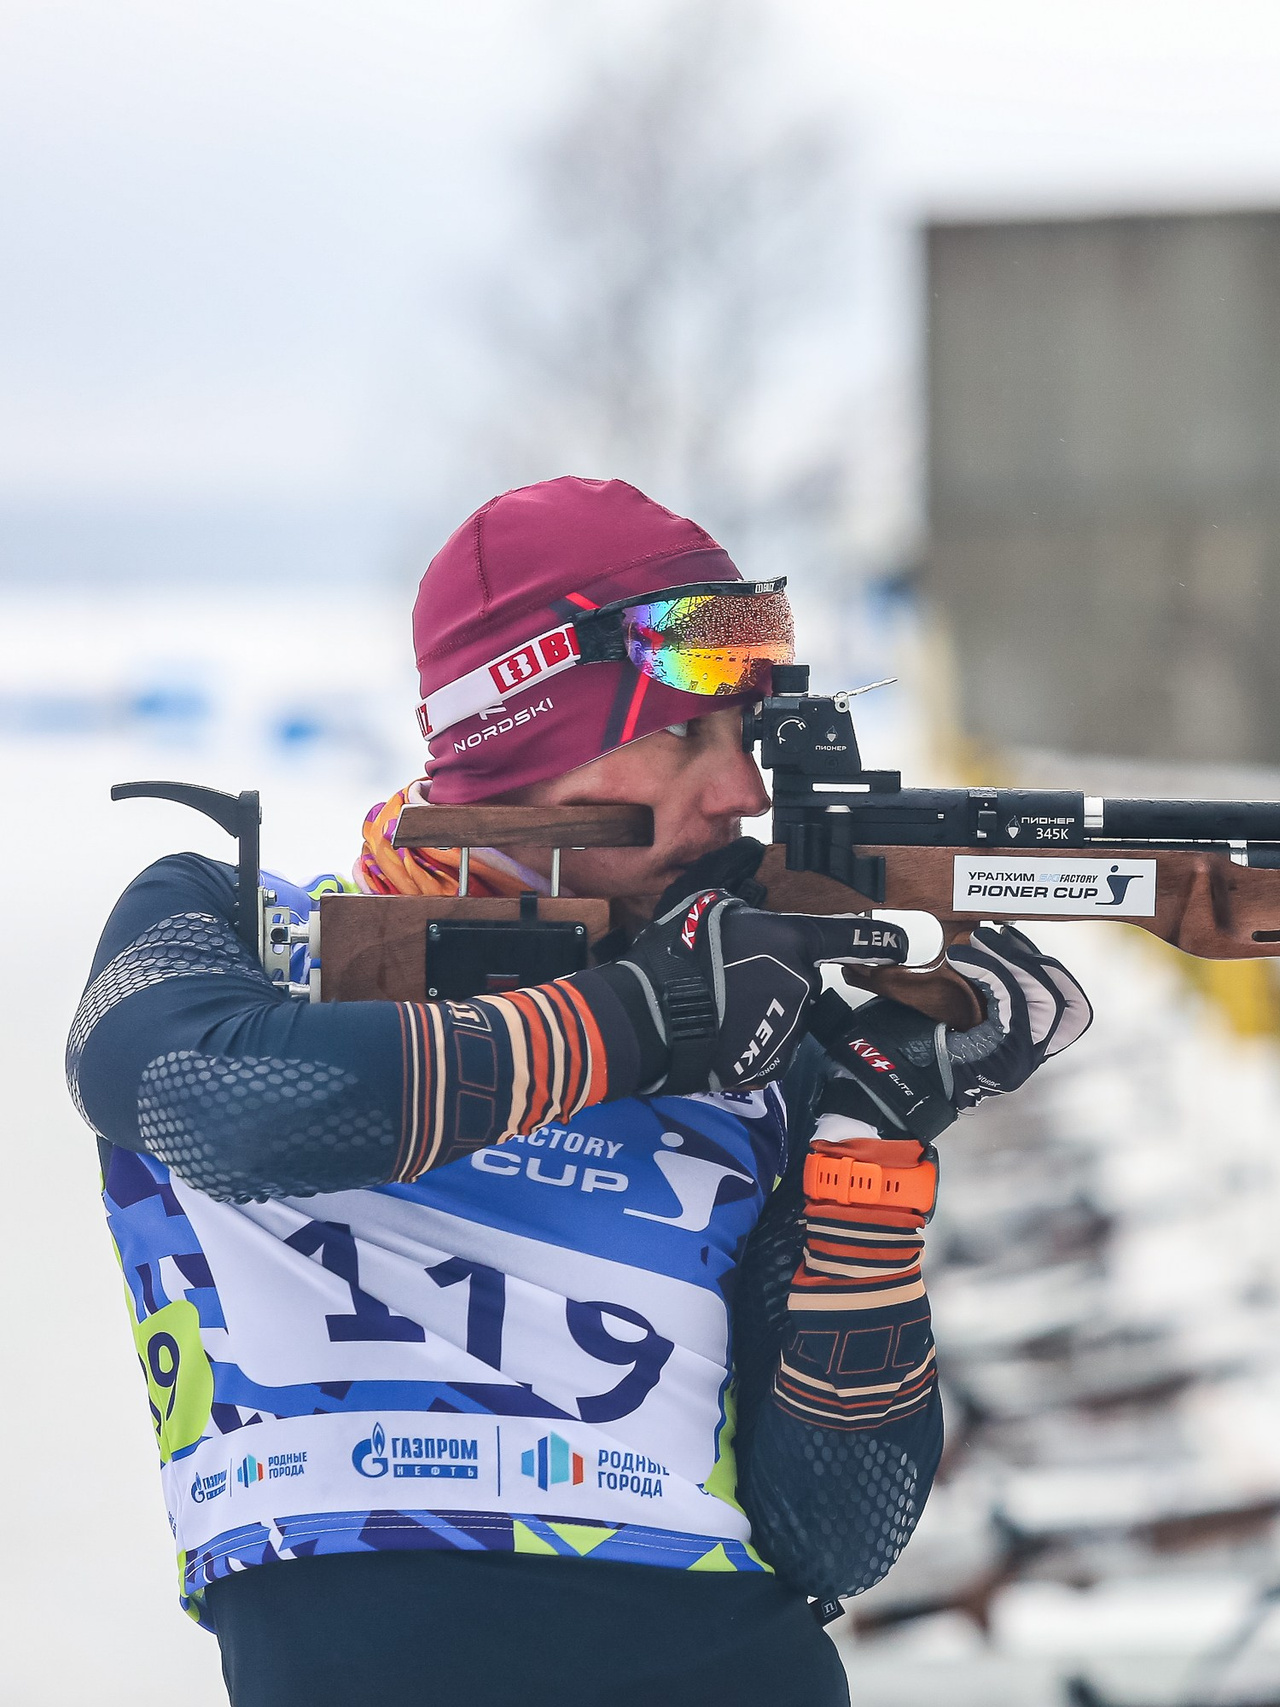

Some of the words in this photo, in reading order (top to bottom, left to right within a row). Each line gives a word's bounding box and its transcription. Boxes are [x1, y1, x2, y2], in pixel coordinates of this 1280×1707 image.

[453, 697, 554, 753] NORDSKI
[1021, 817, 1075, 825] ПИОНЕР
[968, 872, 1035, 882] УРАЛХИМ
[967, 884, 1048, 898] PIONER
[1053, 886, 1099, 899] CUP
[852, 929, 899, 948] LEK
[733, 998, 785, 1076] LEKI
[757, 1057, 780, 1077] NORD
[888, 1073, 914, 1096] ELITE
[470, 1148, 629, 1194] CUP
[283, 1220, 674, 1423] 119
[392, 1438, 478, 1460] ГАЗПРОМ
[268, 1452, 307, 1467] РОДНЫЕ
[268, 1464, 305, 1480] ГОРОДА
[396, 1466, 475, 1478] НЕФТЬ
[598, 1471, 663, 1499] ГОРОДА
